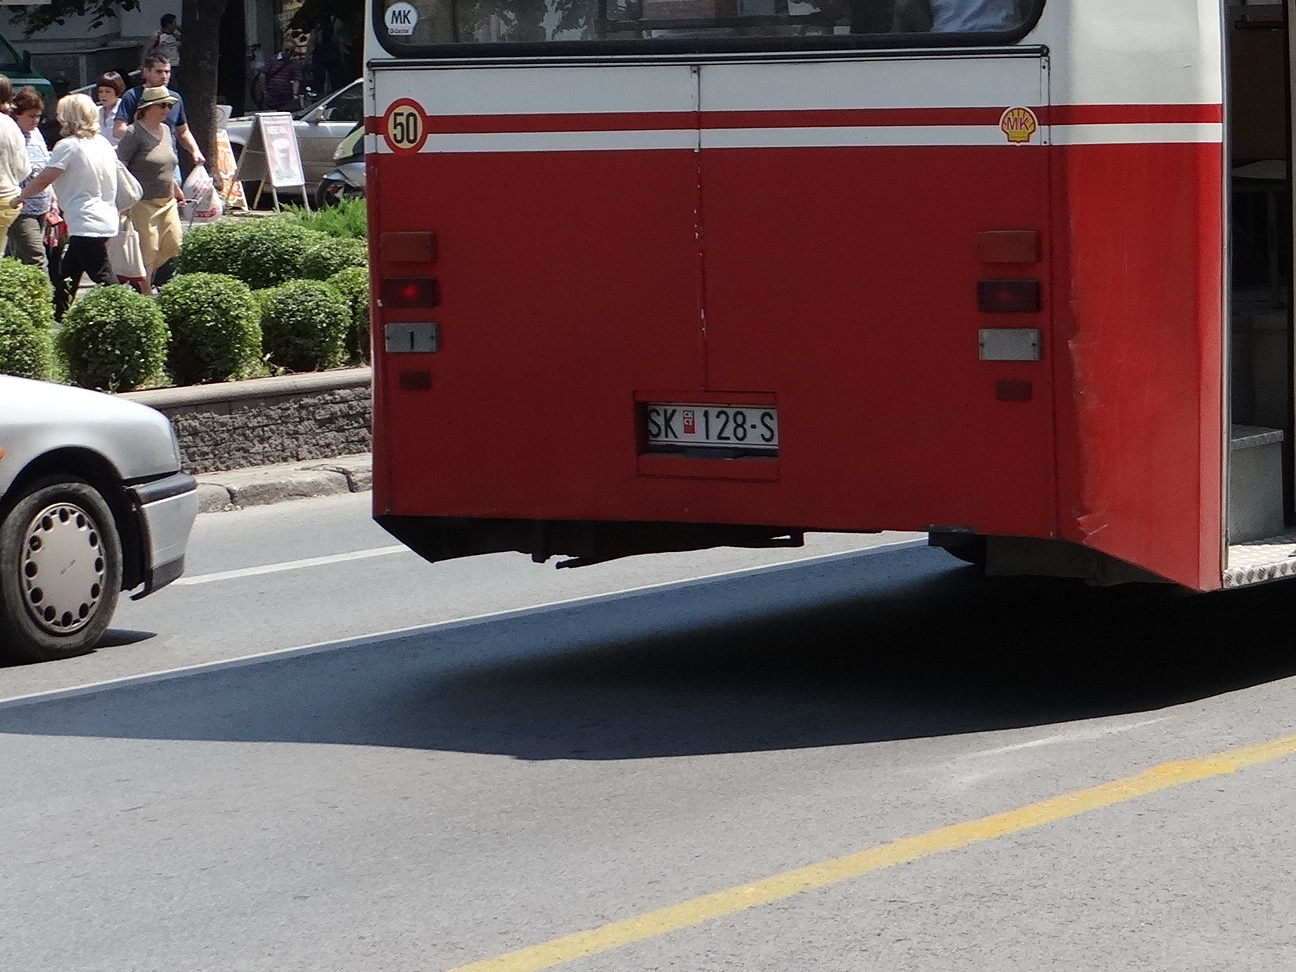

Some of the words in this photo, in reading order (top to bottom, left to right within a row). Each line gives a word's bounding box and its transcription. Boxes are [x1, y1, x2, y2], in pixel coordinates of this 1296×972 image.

[391, 10, 411, 24] MK
[393, 112, 417, 144] 50
[1006, 117, 1029, 130] MK
[648, 409, 678, 439] SK
[703, 410, 774, 442] 128-S
